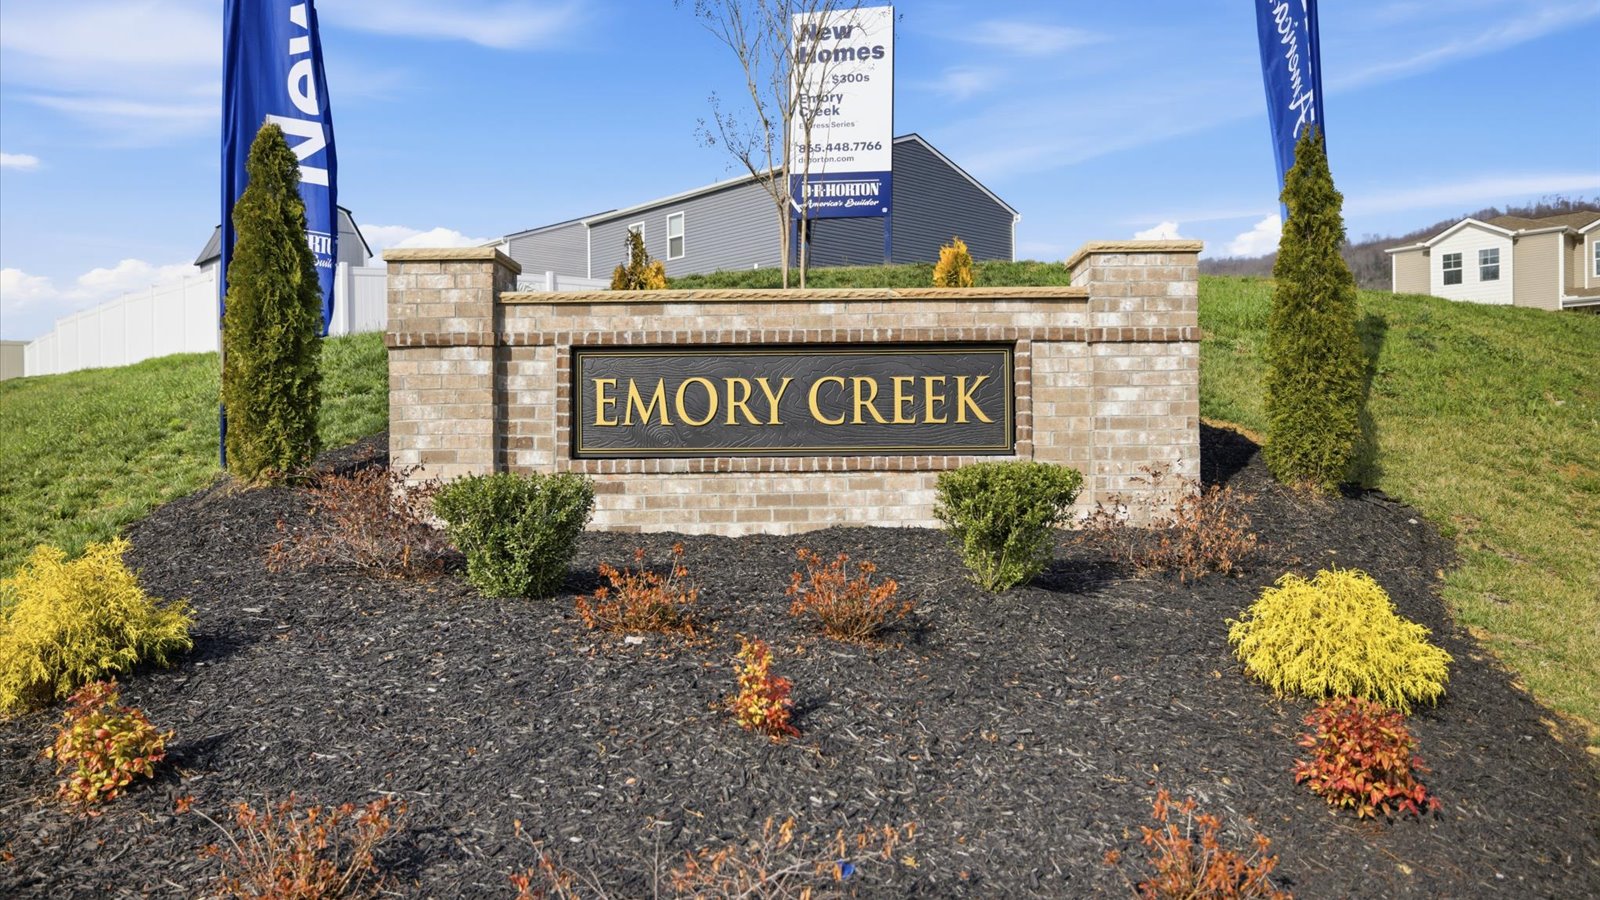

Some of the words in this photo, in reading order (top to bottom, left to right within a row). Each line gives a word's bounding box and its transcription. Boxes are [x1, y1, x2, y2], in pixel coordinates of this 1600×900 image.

[800, 24, 853, 42] New
[800, 45, 885, 64] Homes
[832, 73, 870, 84] $300s
[799, 122, 829, 130] Eress
[844, 198, 879, 208] Builder
[592, 377, 794, 426] EMORY
[808, 375, 995, 425] CREEK
